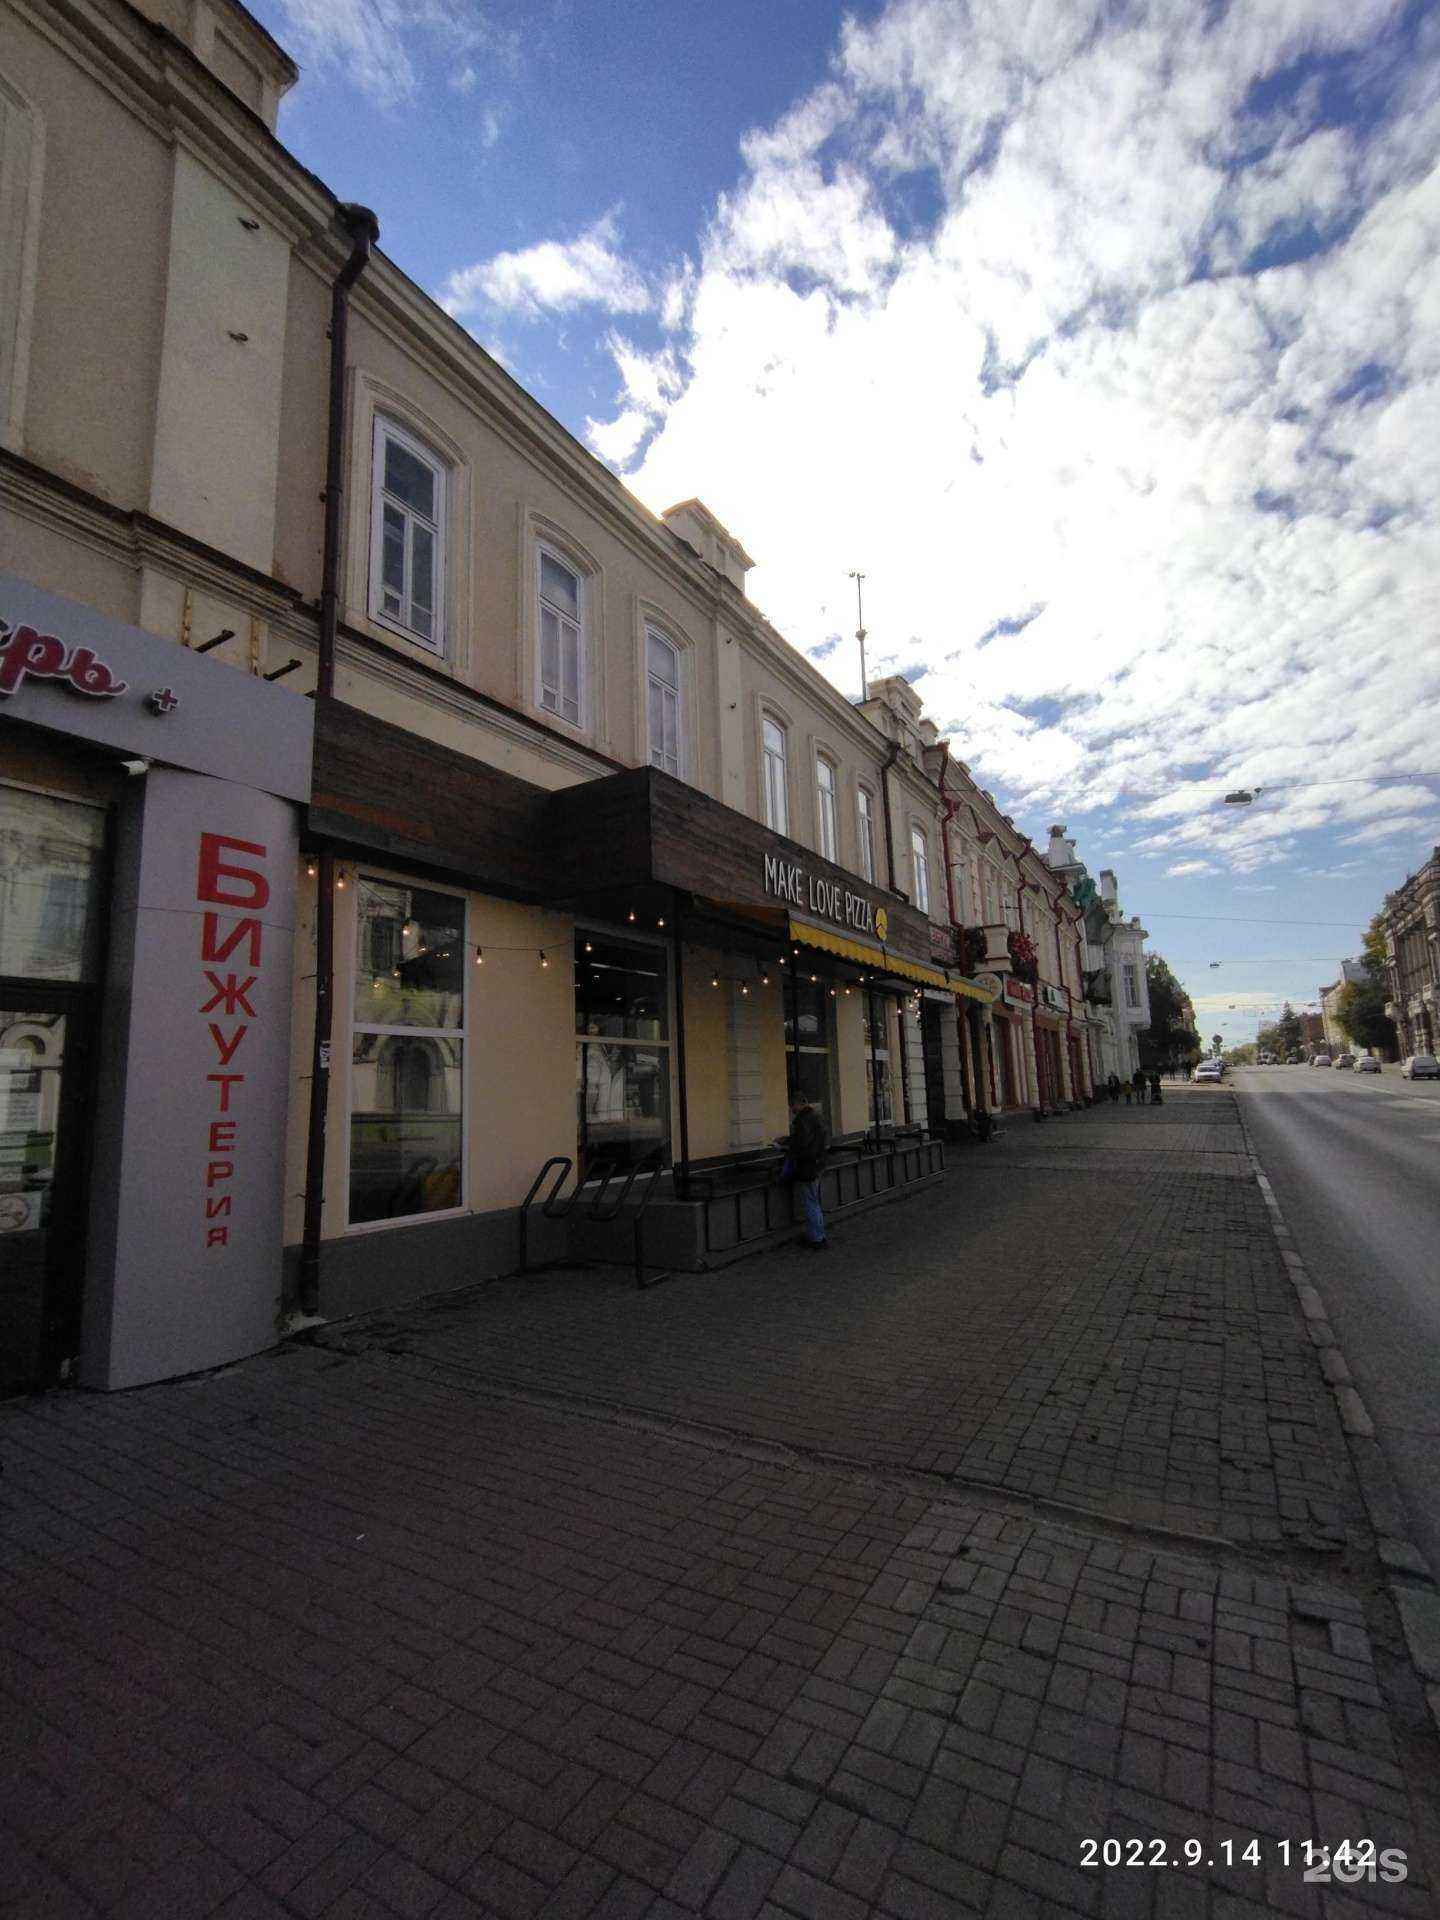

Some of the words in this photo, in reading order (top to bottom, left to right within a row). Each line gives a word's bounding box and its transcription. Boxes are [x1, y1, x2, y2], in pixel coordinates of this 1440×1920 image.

[0, 616, 129, 697] рь
[764, 853, 804, 906] MAKE
[809, 875, 842, 921] LOVE
[844, 891, 874, 933] PIZZA
[196, 831, 270, 1248] БИЖУТЕРИЯ
